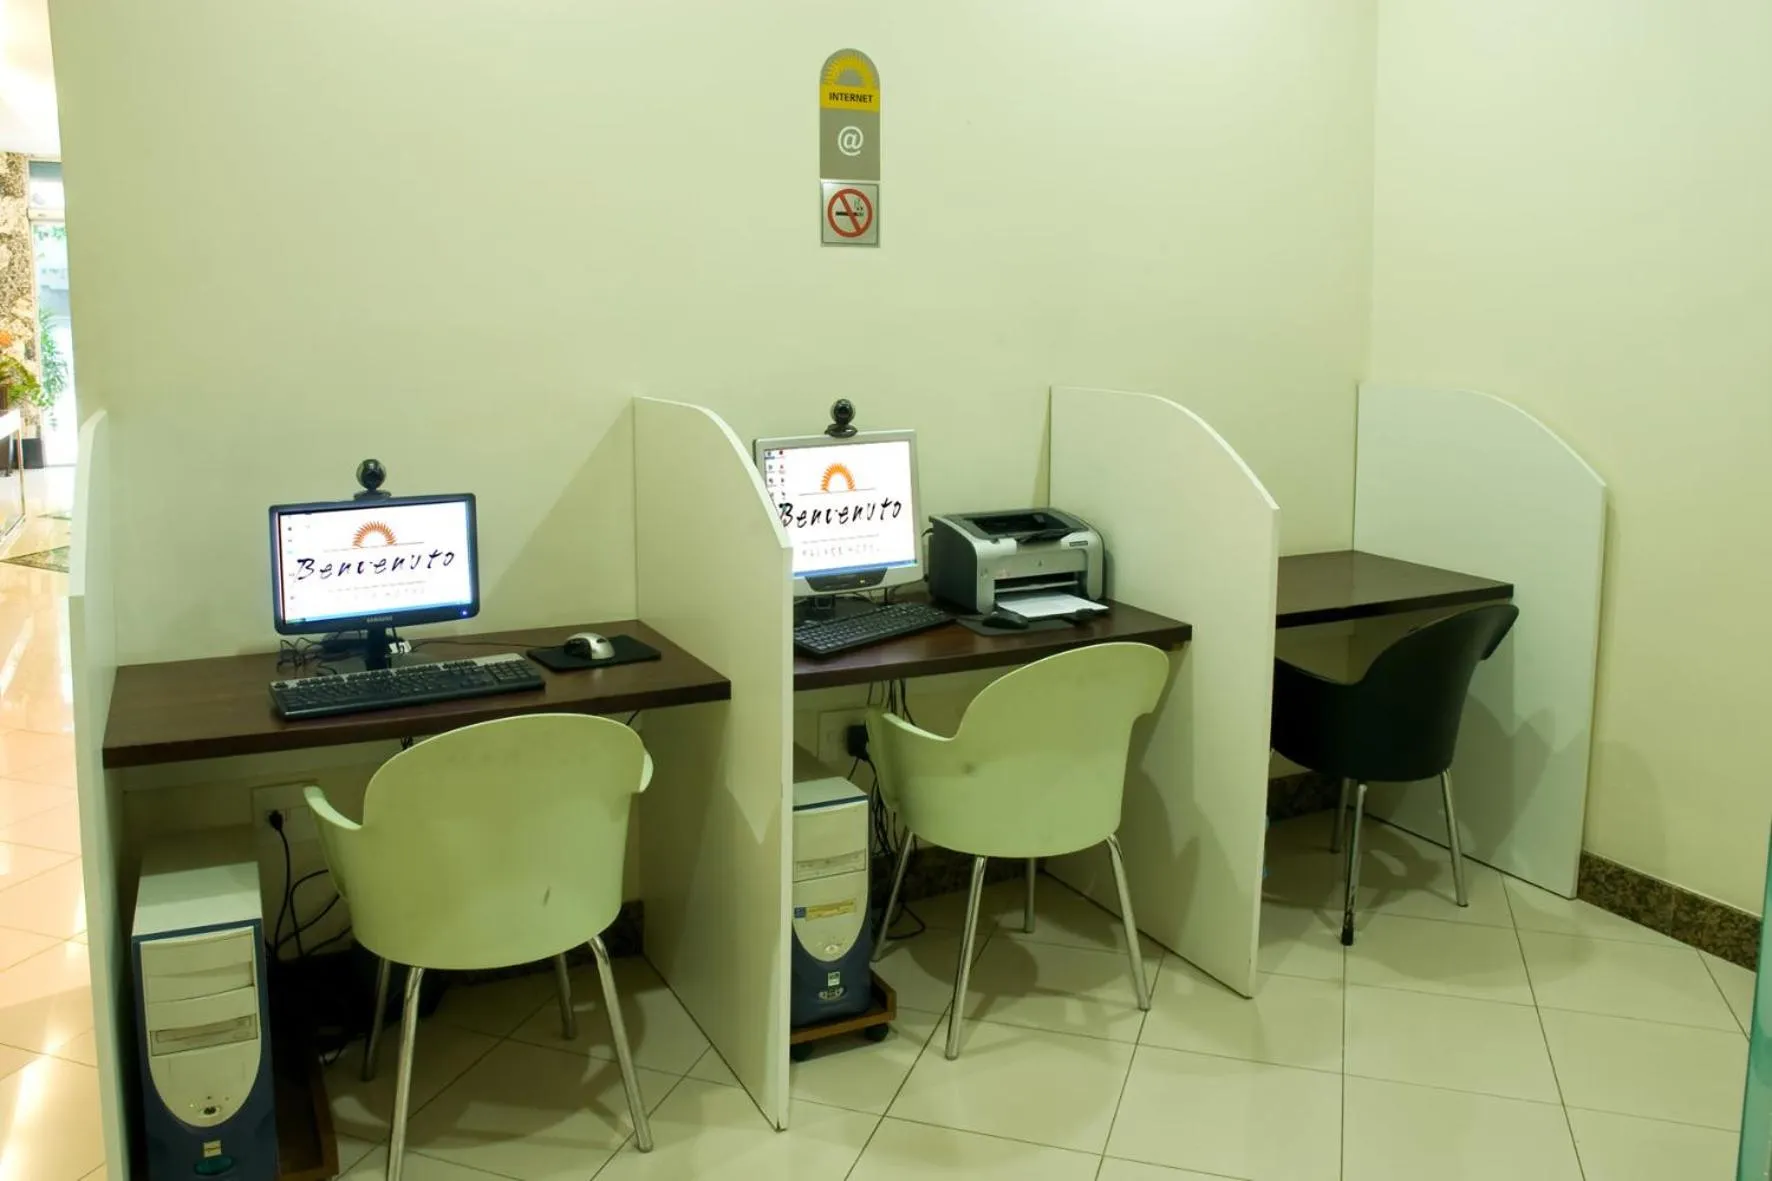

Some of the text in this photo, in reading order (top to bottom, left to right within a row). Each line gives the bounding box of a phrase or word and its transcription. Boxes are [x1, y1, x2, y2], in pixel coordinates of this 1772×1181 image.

[829, 92, 873, 103] INTERNET
[778, 498, 902, 528] Benvenuto
[296, 549, 455, 580] Benvenuto
